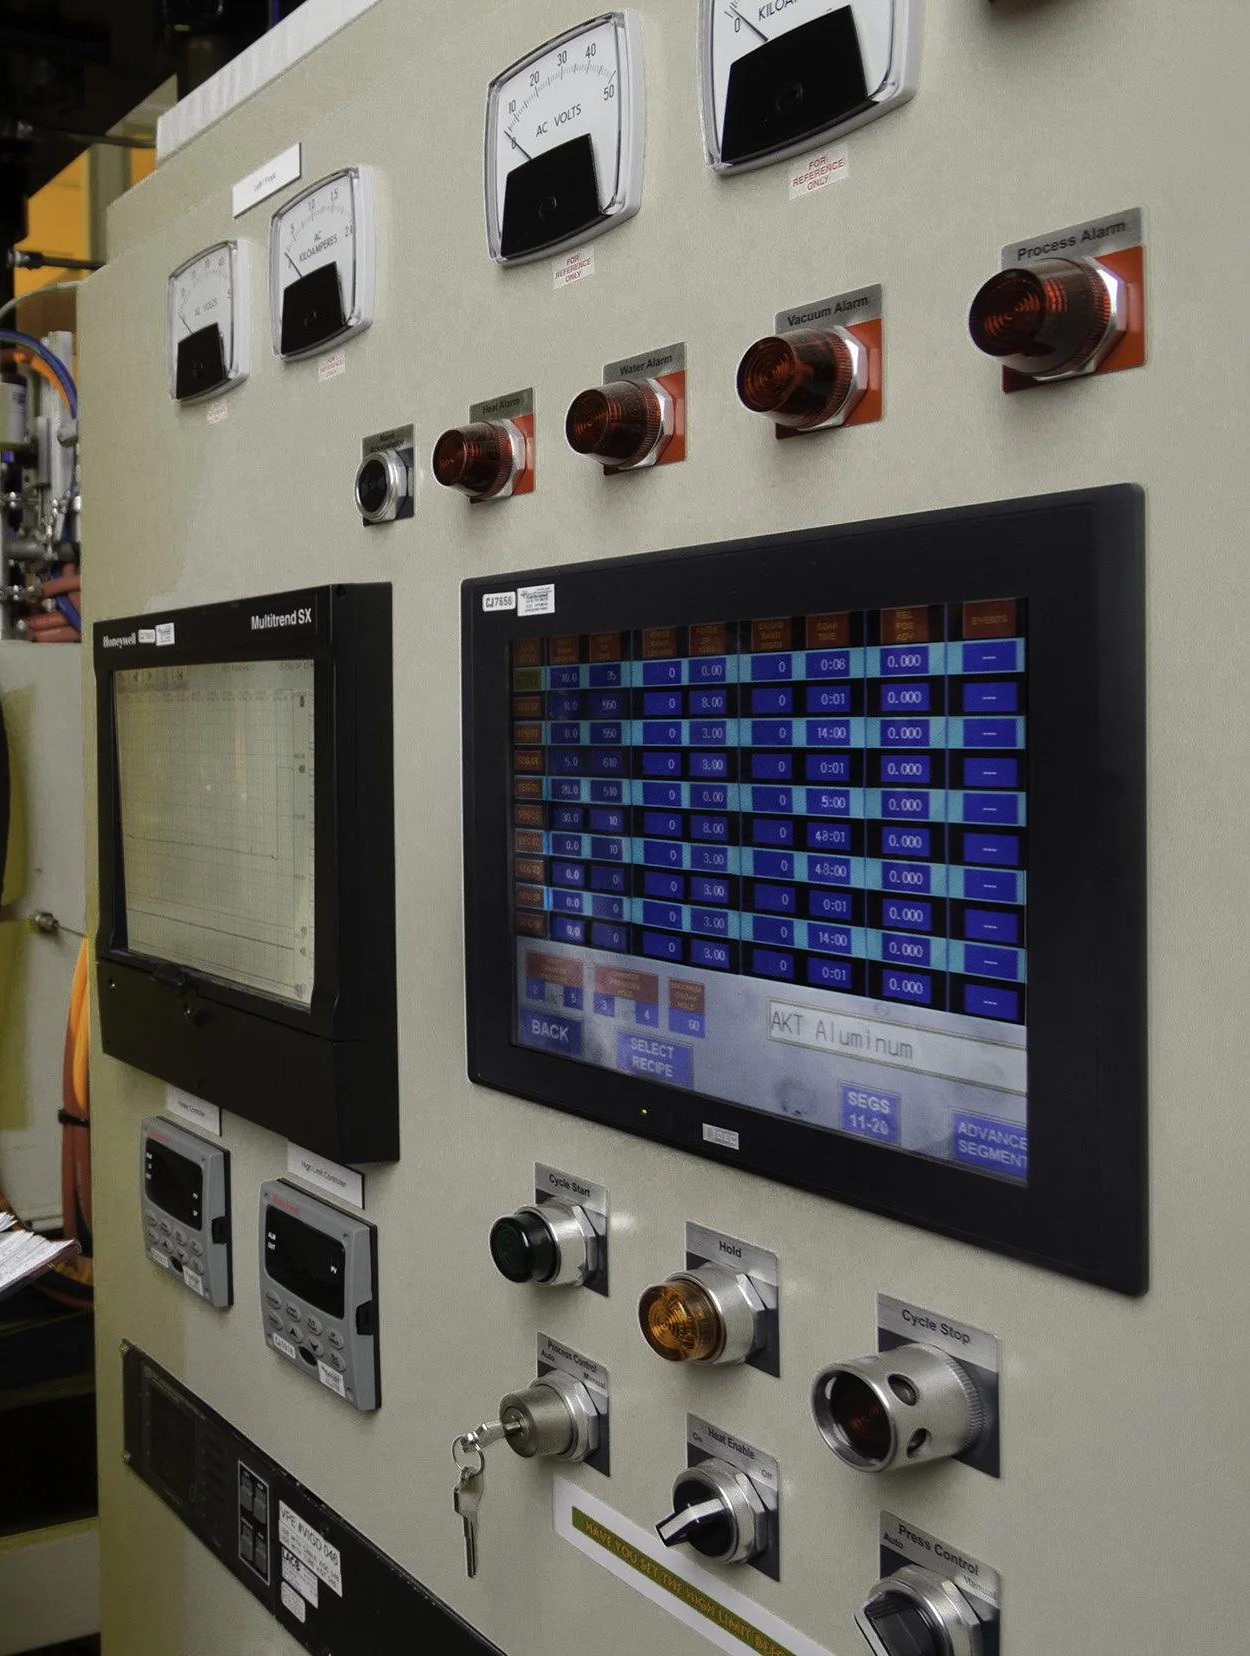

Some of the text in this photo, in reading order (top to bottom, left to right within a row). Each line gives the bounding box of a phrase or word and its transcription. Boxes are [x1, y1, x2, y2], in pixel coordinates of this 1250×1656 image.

[734, 17, 741, 33] 0
[556, 50, 568, 67] 30
[584, 42, 597, 60] 40
[529, 70, 540, 88] 20
[603, 83, 615, 102] 50
[508, 99, 517, 115] 10
[535, 103, 582, 138] AC VOLTS
[792, 157, 844, 189] REFERENCE
[808, 155, 827, 171] FOR
[807, 174, 830, 191] ONLY
[1017, 221, 1126, 261] Process Alarm
[555, 257, 591, 280] REFERENCE
[566, 254, 579, 266] FOR
[565, 270, 581, 283] ONLY
[787, 295, 869, 327] Vacuum Alarm
[619, 353, 672, 376] Water Alarm
[482, 397, 520, 415] Heat Alarm
[250, 608, 312, 630] Multitrend SX
[103, 631, 137, 650] Honeywell
[561, 671, 578, 683] 10.0
[668, 667, 676, 679] 0
[701, 664, 723, 677] 0.00
[778, 660, 786, 673] 0
[887, 654, 922, 668] 0.000
[668, 697, 676, 709] 0
[701, 696, 723, 709] 8.00
[778, 694, 786, 707] 0
[820, 692, 845, 706] 0:01
[887, 690, 922, 704] 0.000
[668, 727, 677, 739] 0
[702, 727, 723, 739] 3.00
[778, 727, 787, 739] 0
[817, 726, 847, 739] 14:00
[887, 726, 922, 740] 0.000
[602, 757, 618, 768] 610
[667, 758, 675, 770] 0
[702, 758, 724, 771] 3.00
[778, 760, 786, 773] 0
[819, 761, 844, 774] 0:01
[887, 762, 922, 776] 0.000
[561, 784, 580, 797] 20.0
[668, 789, 676, 801] 0
[702, 790, 724, 803] 0.00
[779, 794, 787, 806] 0
[821, 795, 847, 809] 5:00
[888, 798, 922, 812] 0.000
[609, 815, 618, 826] 10
[668, 819, 676, 831] 0
[702, 822, 725, 834] 8.00
[779, 826, 787, 839] 0
[815, 830, 845, 843] 48:01
[888, 834, 922, 849] 0.000
[565, 840, 923, 885] 0.0 10 0 3.00 0 48:00 0.000
[565, 868, 924, 923] 0.0 0 0 3.00 0 0:01 0.000
[612, 903, 619, 914] 0
[669, 910, 677, 922] 0
[703, 915, 725, 929] 3.00
[780, 926, 788, 938] 0
[819, 931, 848, 947] 14:00
[889, 941, 924, 958] 0.000
[613, 932, 619, 944] 0
[668, 942, 676, 953] 0
[704, 947, 726, 962] 3.00
[779, 959, 788, 972] 0
[821, 966, 846, 981] 0:01
[889, 977, 924, 995] 0.000
[570, 992, 578, 1004] 5
[600, 1000, 609, 1012] 3
[643, 1008, 652, 1022] 4
[531, 1018, 570, 1044] BACK
[771, 1008, 913, 1060] AKT Aluminum
[630, 1037, 674, 1060] SELECT
[631, 1055, 674, 1079] RECIPE
[846, 1090, 891, 1115] SEGS
[849, 1113, 890, 1136] 11-20
[957, 1121, 1027, 1151] ADVANCE
[957, 1139, 1027, 1169] SEGMENT
[549, 1173, 591, 1199] Cycle Start
[718, 1240, 742, 1259] Hold
[901, 1309, 972, 1345] Cycle Stop
[547, 1340, 597, 1373] Process Control
[692, 1432, 703, 1443] On
[707, 1427, 755, 1460] Heat Enable
[883, 1531, 904, 1550] Auto
[898, 1523, 979, 1577] Press Control
[615, 1540, 638, 1564] YOU
[717, 1608, 750, 1640] LIMIT
